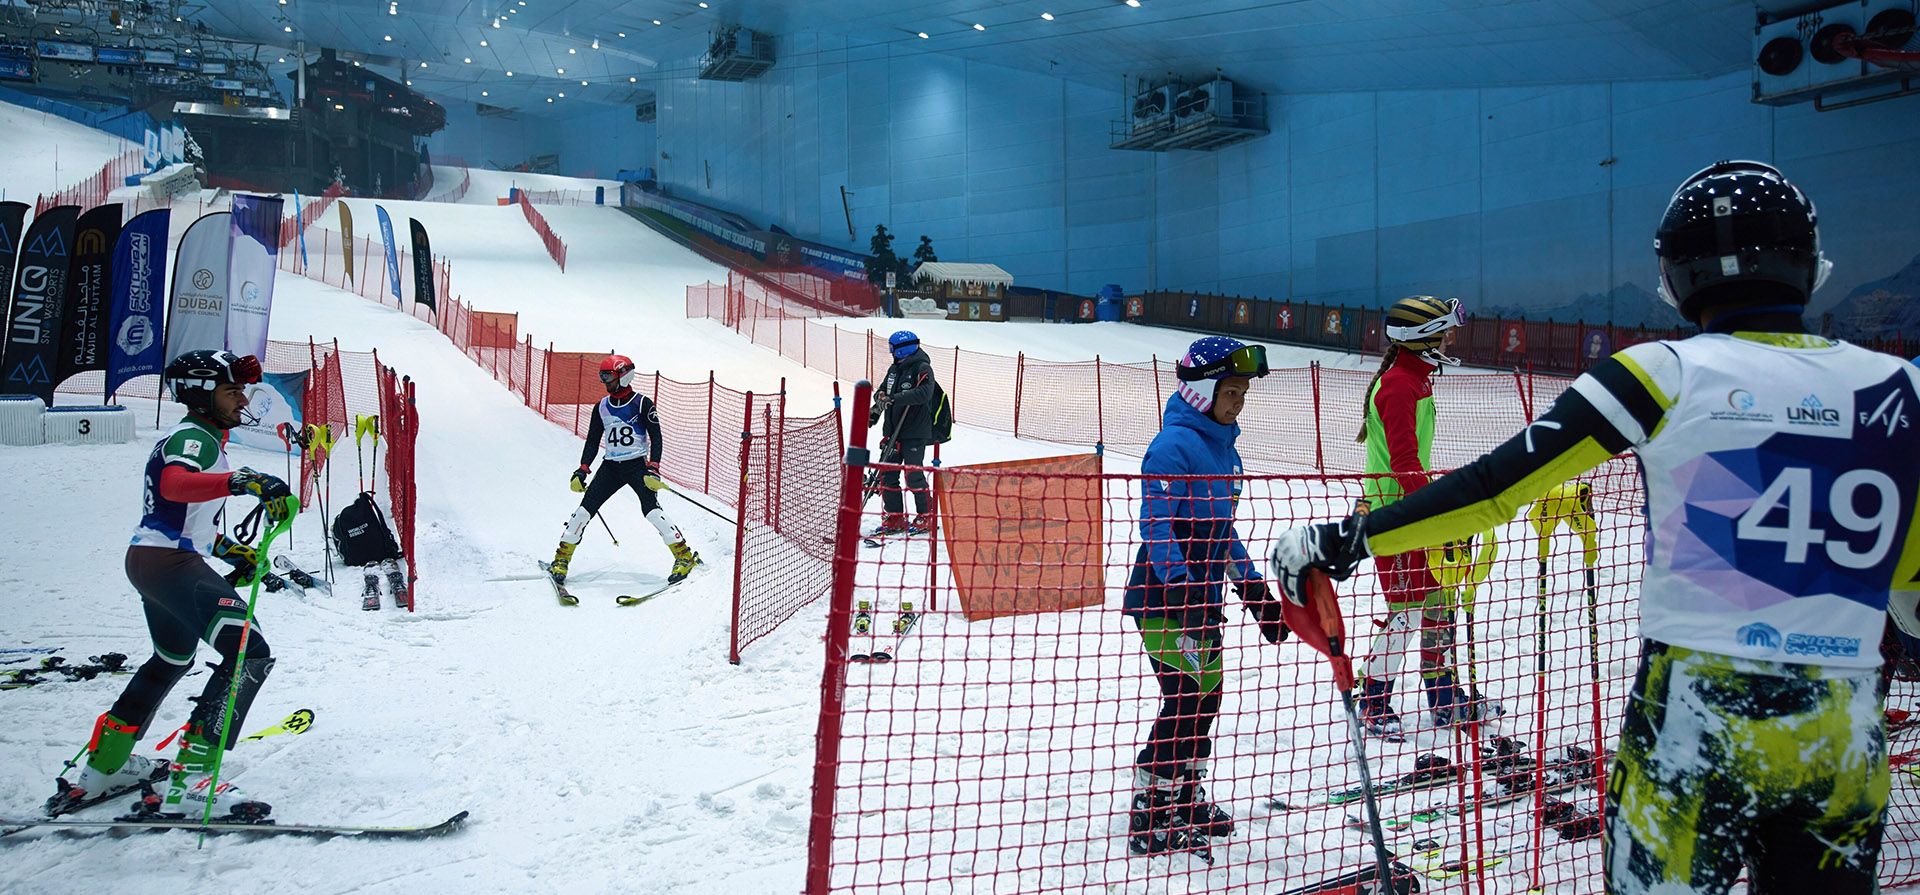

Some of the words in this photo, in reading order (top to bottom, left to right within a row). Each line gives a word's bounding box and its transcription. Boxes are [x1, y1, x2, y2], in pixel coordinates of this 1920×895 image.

[131, 234, 142, 282] DUBAI
[91, 264, 102, 312] FUTTAIM
[130, 285, 140, 310] SKI
[178, 297, 222, 311] DUBAI
[90, 315, 98, 329] AL
[86, 332, 96, 365] MAJID
[1787, 407, 1840, 422] UNIQ
[78, 419, 91, 435] 3
[608, 426, 635, 447] 48
[1737, 467, 1900, 569] 49
